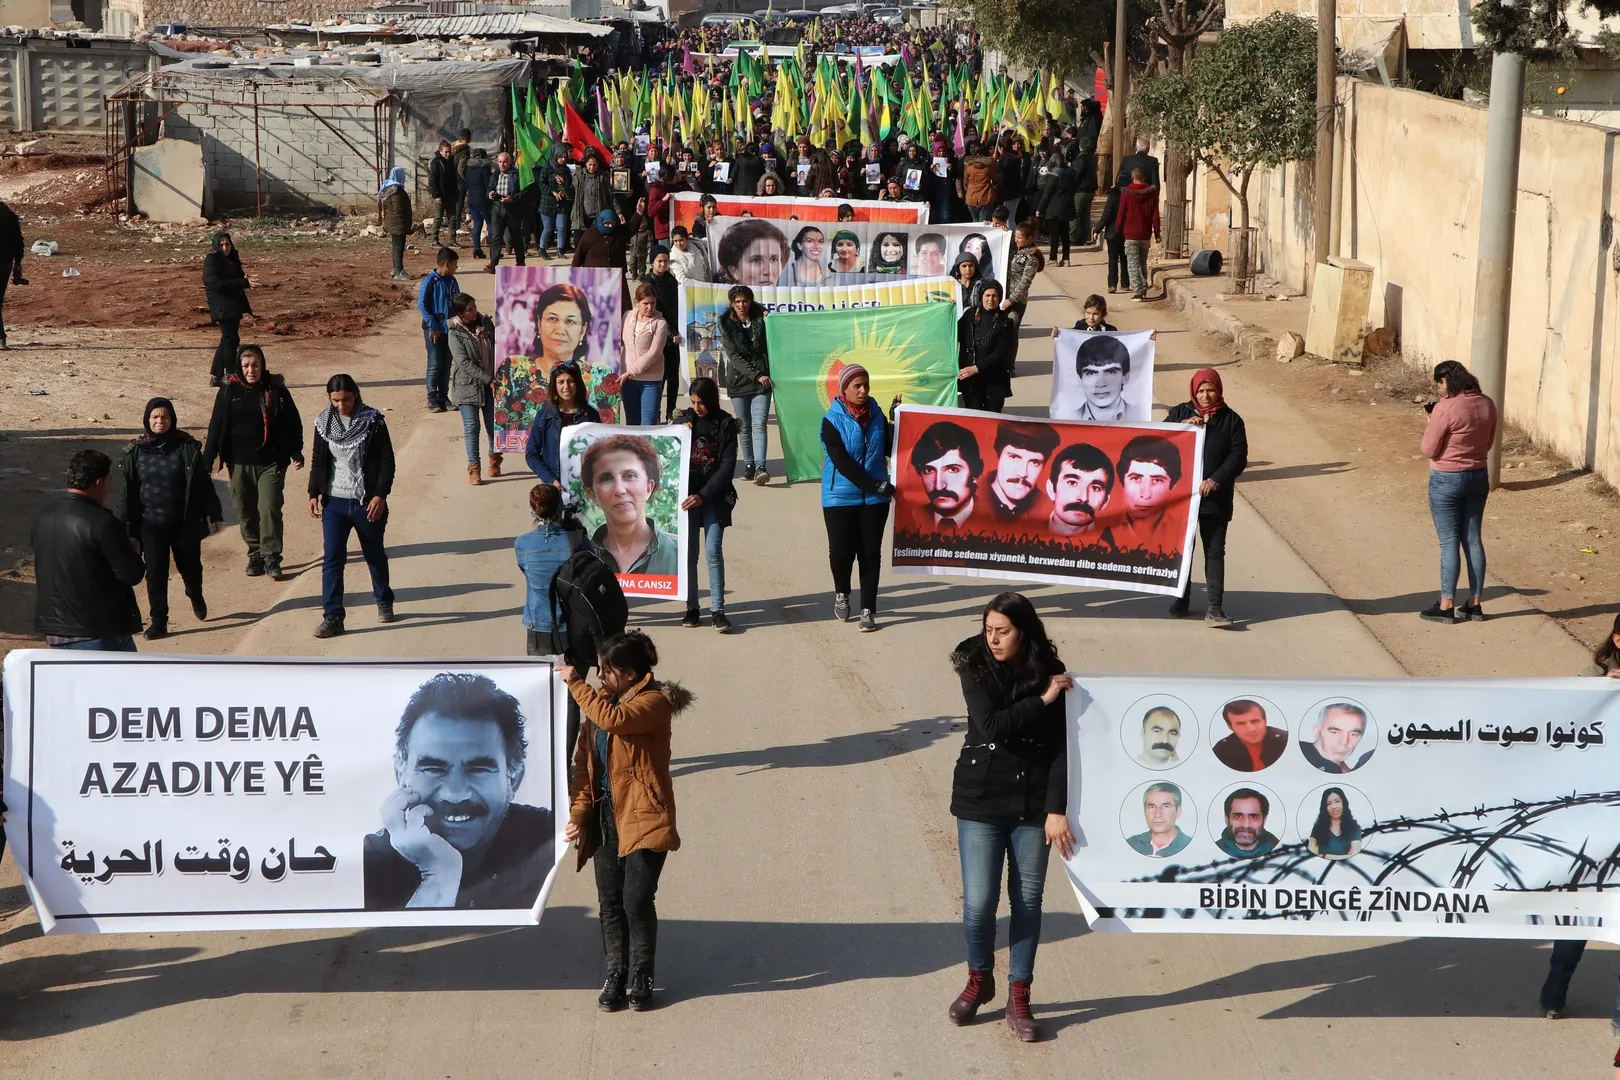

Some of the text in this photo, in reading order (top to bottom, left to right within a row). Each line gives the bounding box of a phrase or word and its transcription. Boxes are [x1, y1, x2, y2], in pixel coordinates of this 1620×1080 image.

[762, 301, 825, 313] ECRÎDA
[893, 548, 1178, 579] Teslimiyet dibe sedema xiyanetê, berxwedan dibe sedema serfiraziyê
[617, 578, 672, 590] ÎNA CANSIZ
[88, 706, 318, 740] DEM DEMA
[1387, 718, 1604, 750] كونوا صوت السجون
[79, 753, 325, 795] AZADIYE YÊ
[60, 837, 337, 884] حان وقت الحرية
[1199, 883, 1490, 914] BİBİN DENGÊ ZÎNDANA
